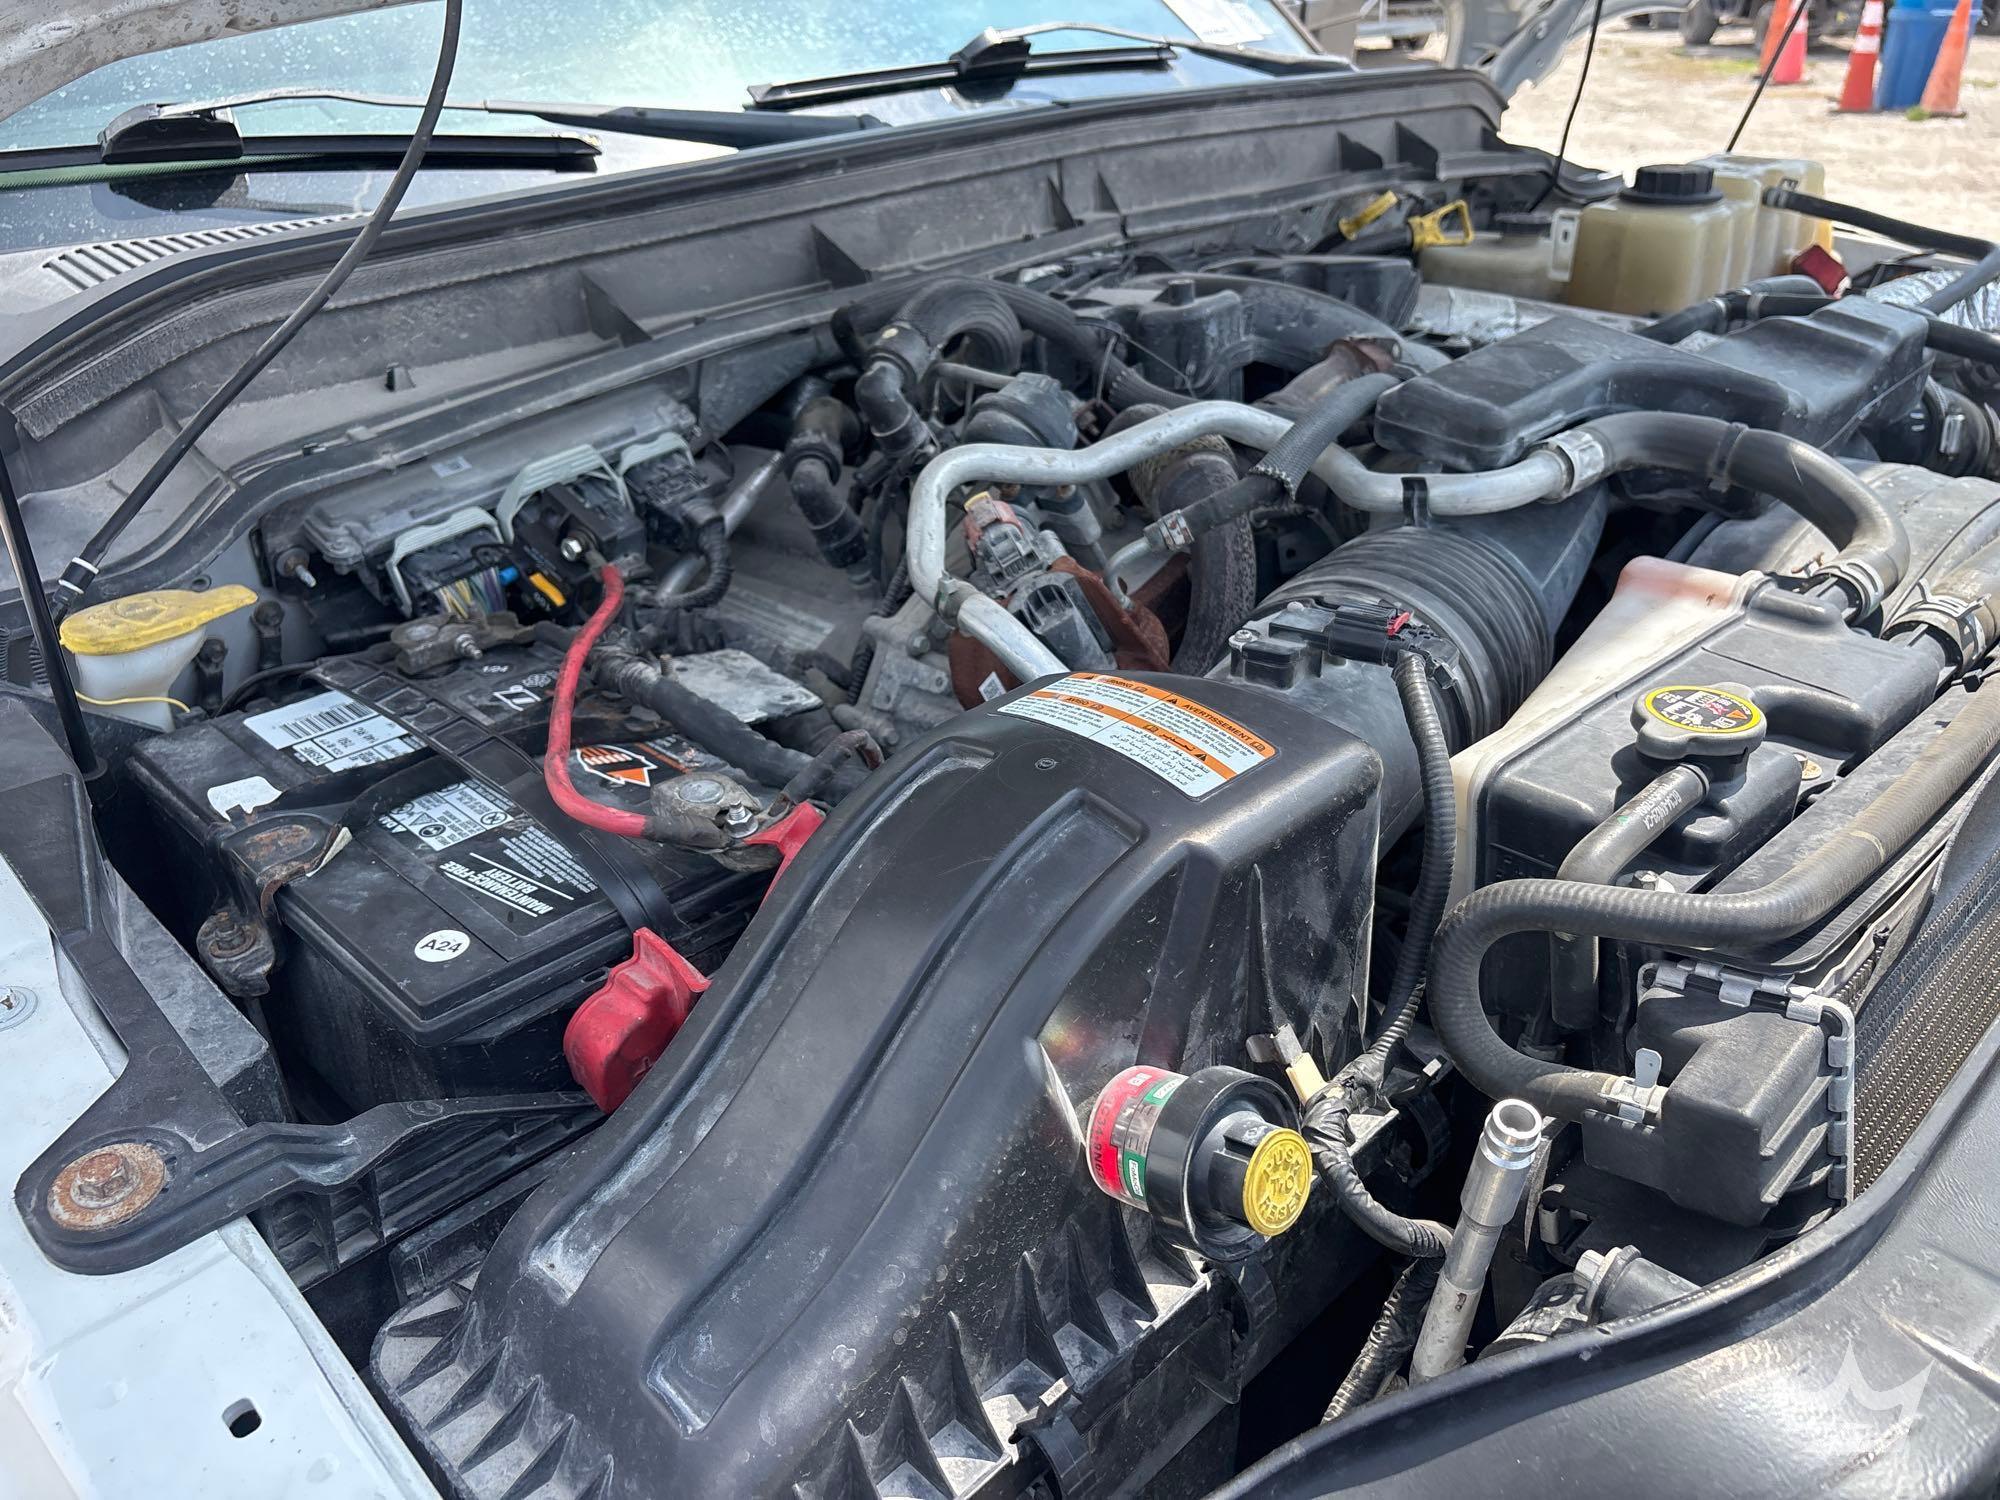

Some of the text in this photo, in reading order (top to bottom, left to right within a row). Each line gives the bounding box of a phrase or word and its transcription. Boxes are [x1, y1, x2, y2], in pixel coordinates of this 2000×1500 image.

[1183, 704, 1251, 741] AVERTISSEMENT
[438, 860, 554, 916] MAINTENANCE-FREE
[482, 868, 539, 895] BATTERY
[419, 939, 463, 953] A24
[1130, 1161, 1142, 1196] FoMoCo
[1263, 1148, 1300, 1183] PUSH
[1270, 1175, 1295, 1196] TO
[1259, 1189, 1305, 1220] RESET
